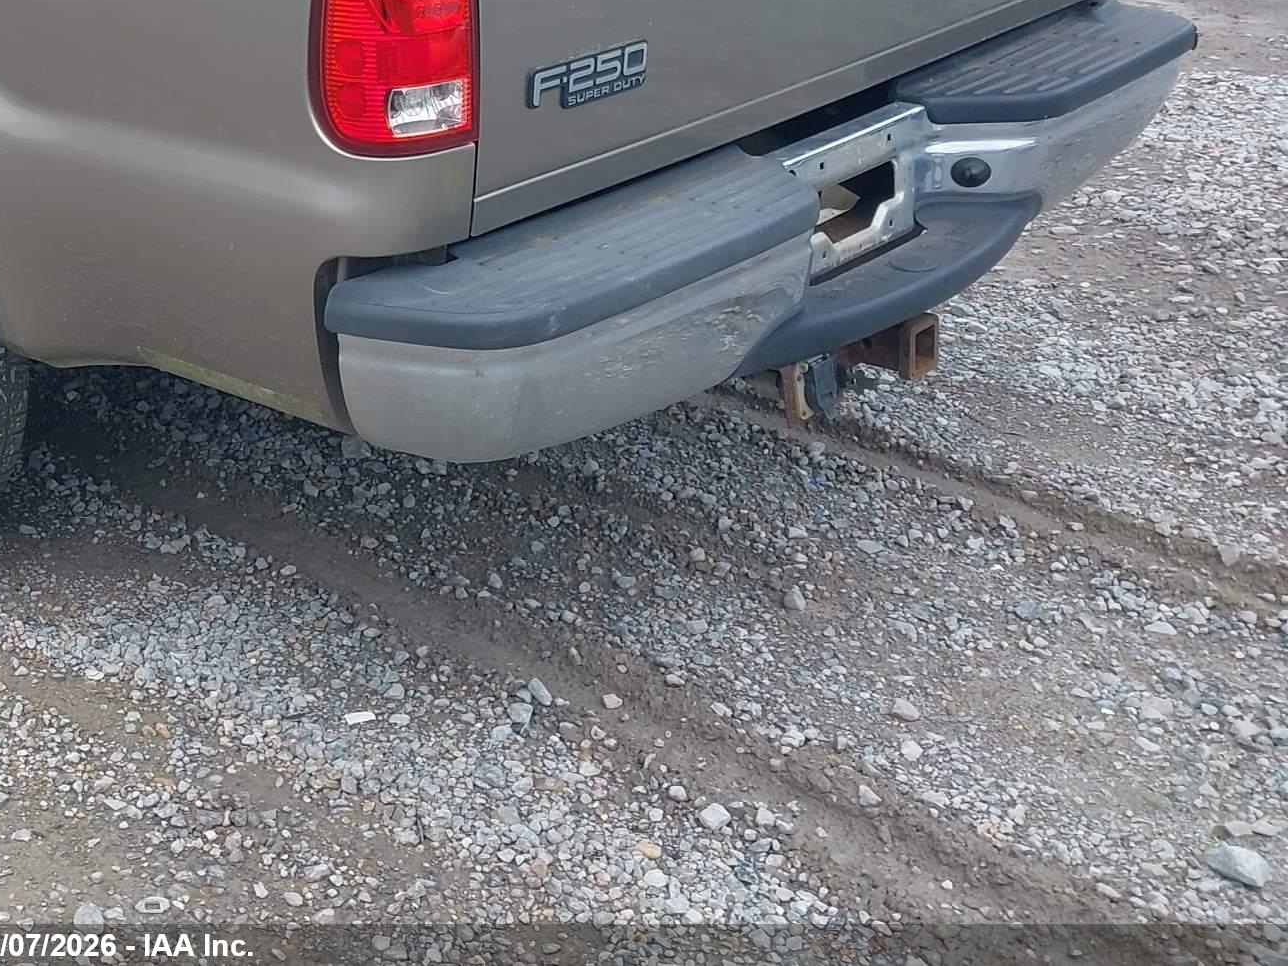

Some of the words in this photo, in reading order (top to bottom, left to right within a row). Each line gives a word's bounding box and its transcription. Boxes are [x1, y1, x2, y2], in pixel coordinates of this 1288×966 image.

[532, 41, 648, 107] F-250
[567, 85, 610, 106] SUPER
[613, 74, 646, 92] DUTY
